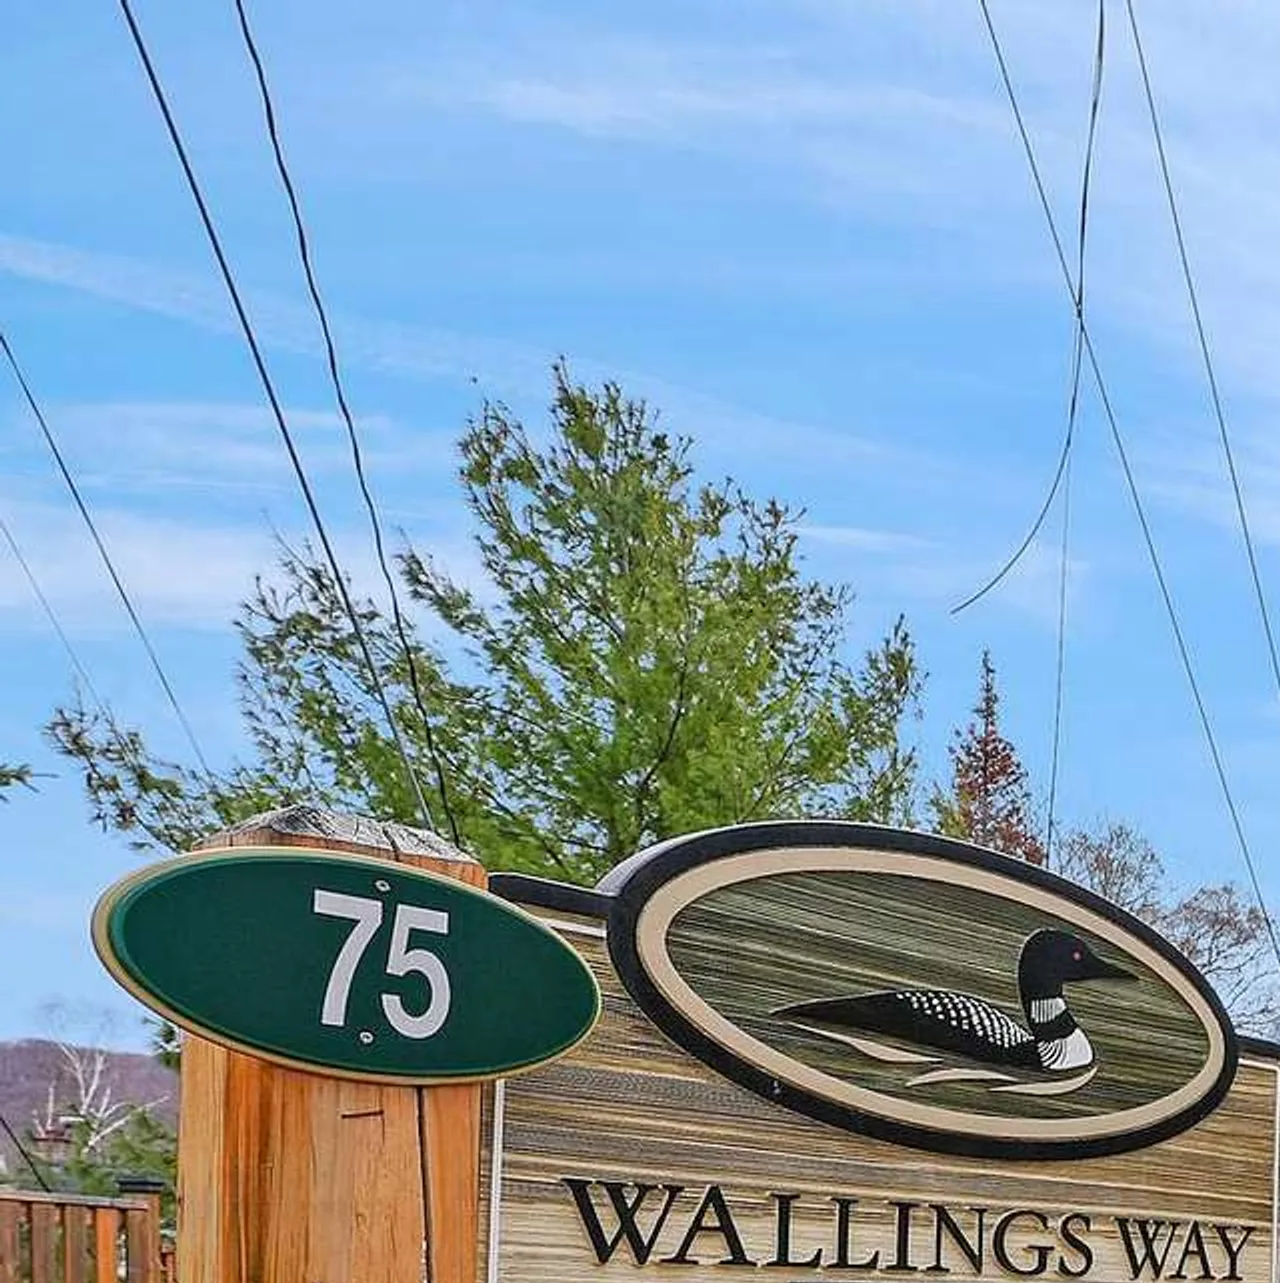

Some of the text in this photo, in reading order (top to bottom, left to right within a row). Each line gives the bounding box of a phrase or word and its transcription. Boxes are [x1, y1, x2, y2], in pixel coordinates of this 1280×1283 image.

[313, 889, 451, 1040] 75
[561, 1178, 1256, 1282] WALLINGS WAY
